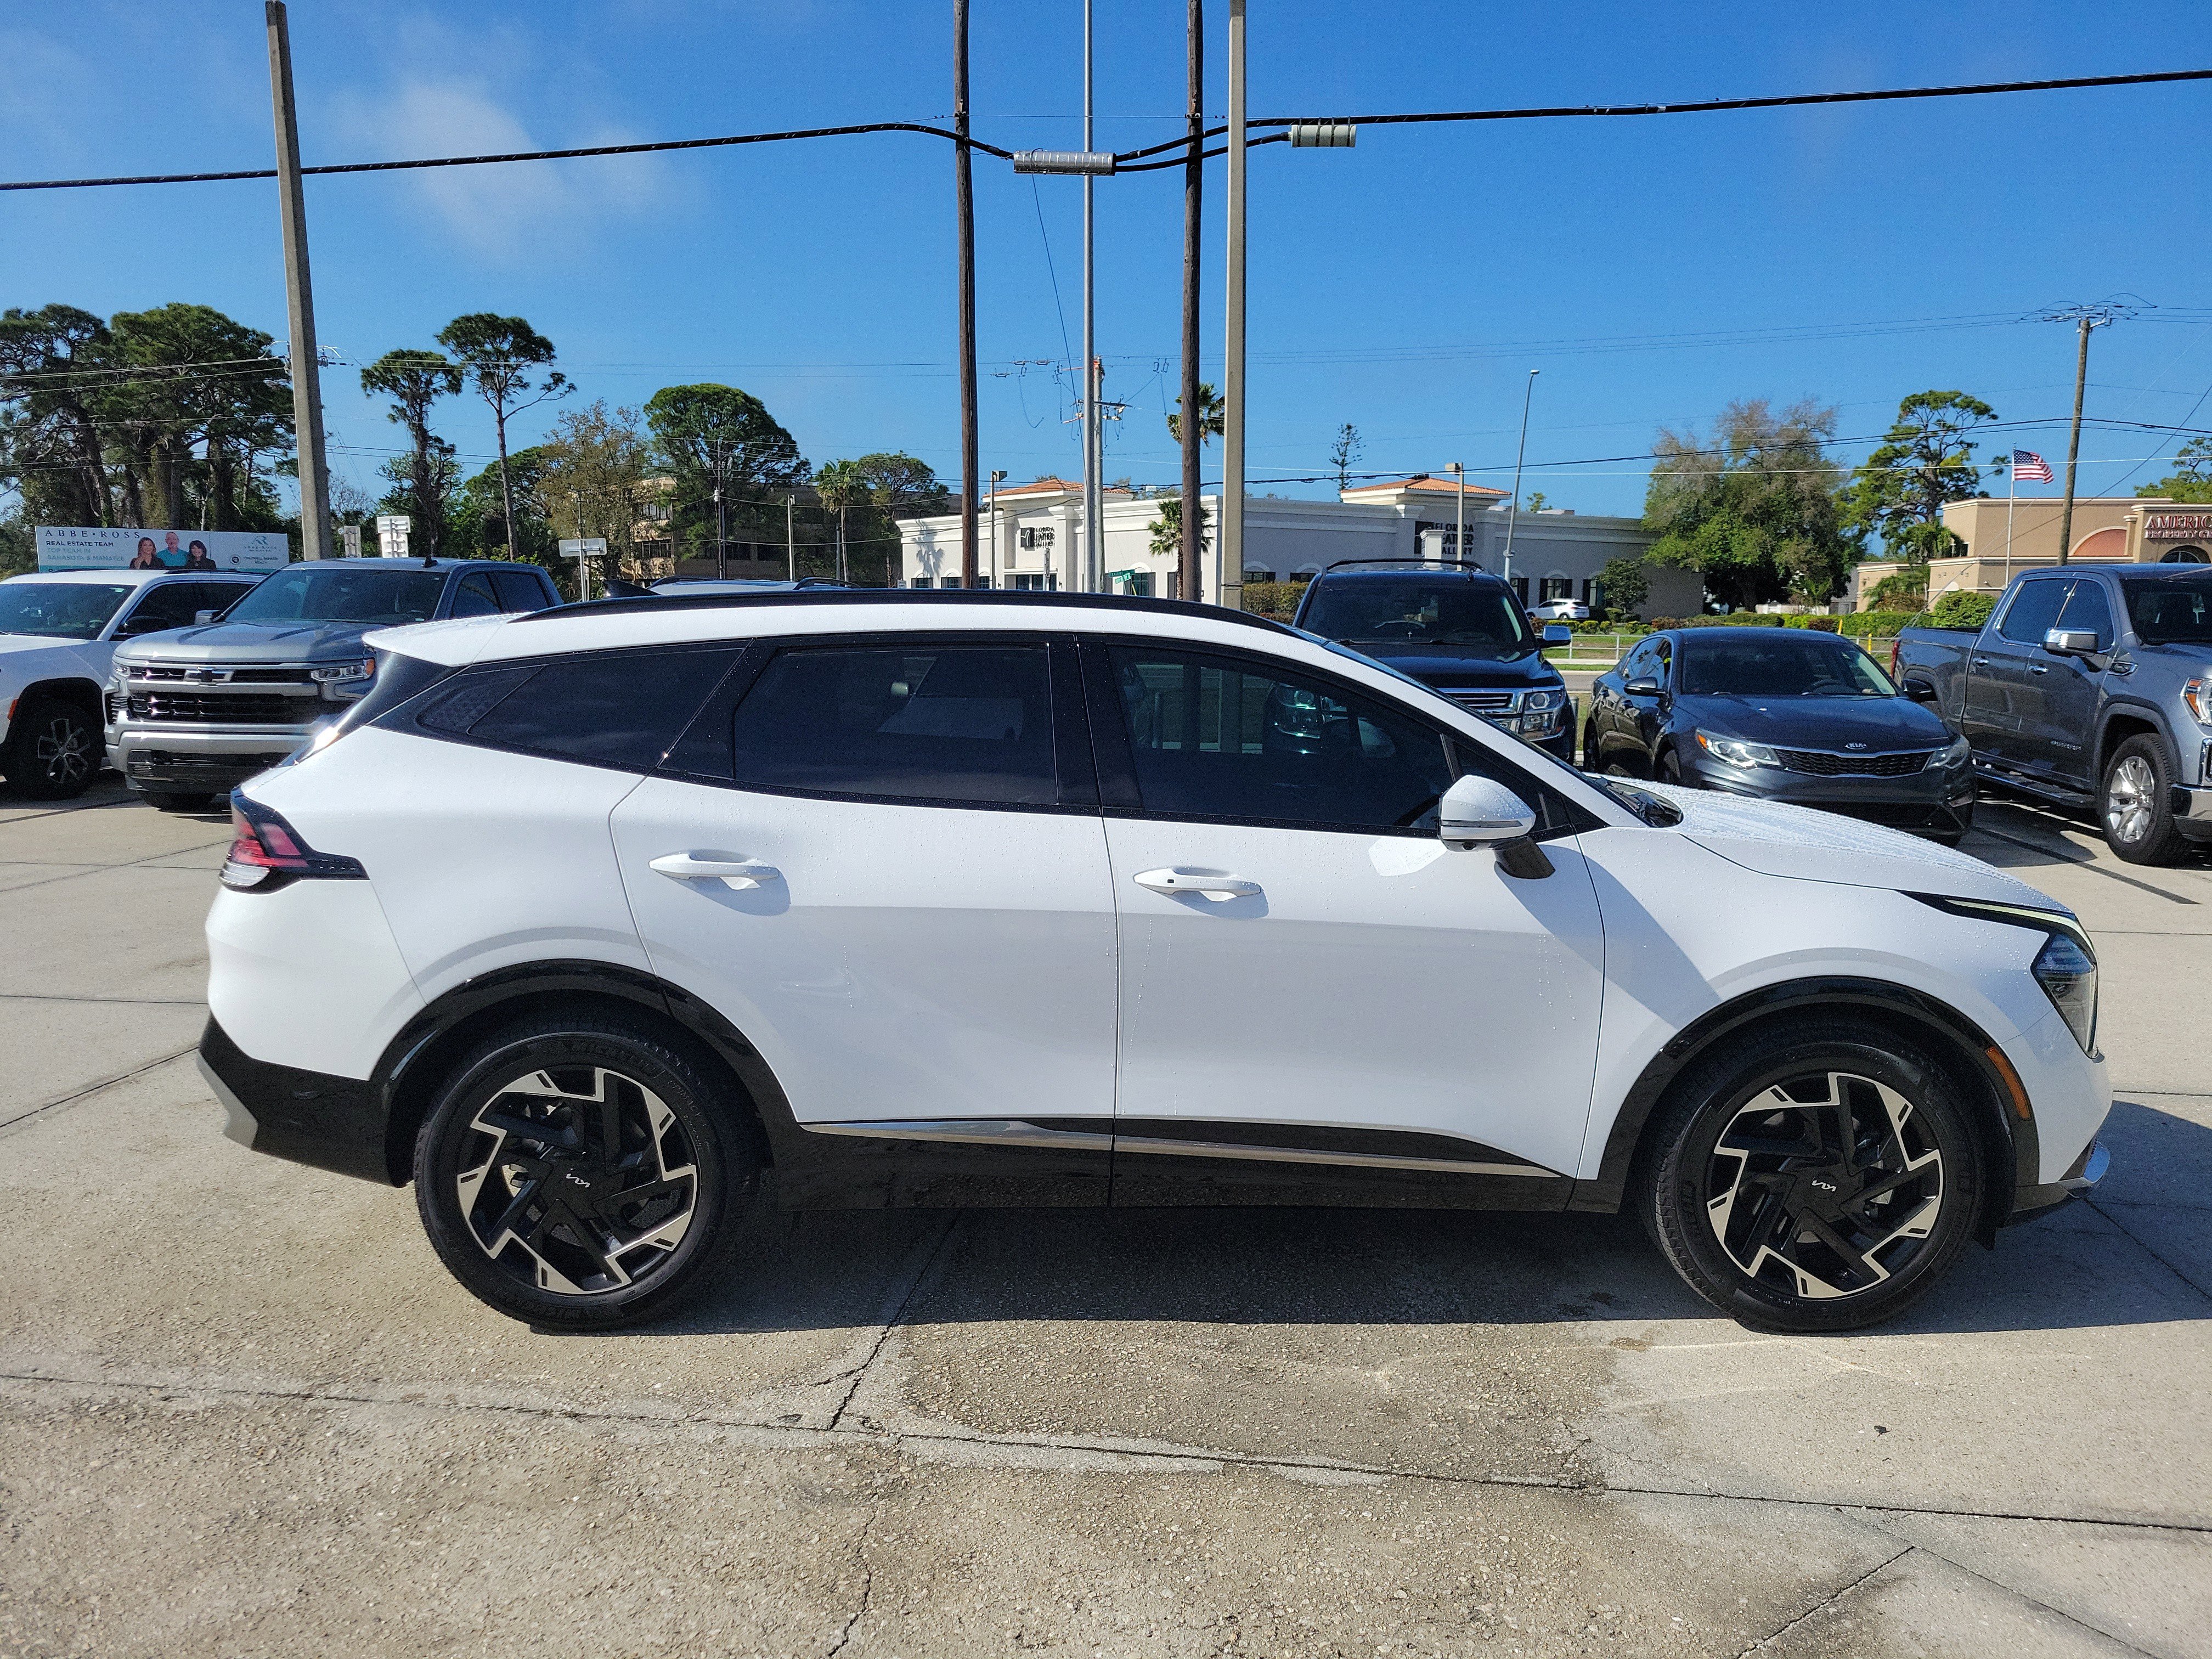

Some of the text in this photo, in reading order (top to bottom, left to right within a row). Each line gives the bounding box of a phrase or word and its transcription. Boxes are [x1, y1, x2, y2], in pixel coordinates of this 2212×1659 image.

[2143, 515, 2212, 529] AMERIC
[1435, 523, 1474, 532] FLORDA
[1442, 533, 1474, 545] EATER
[1442, 546, 1473, 555] ALLRY
